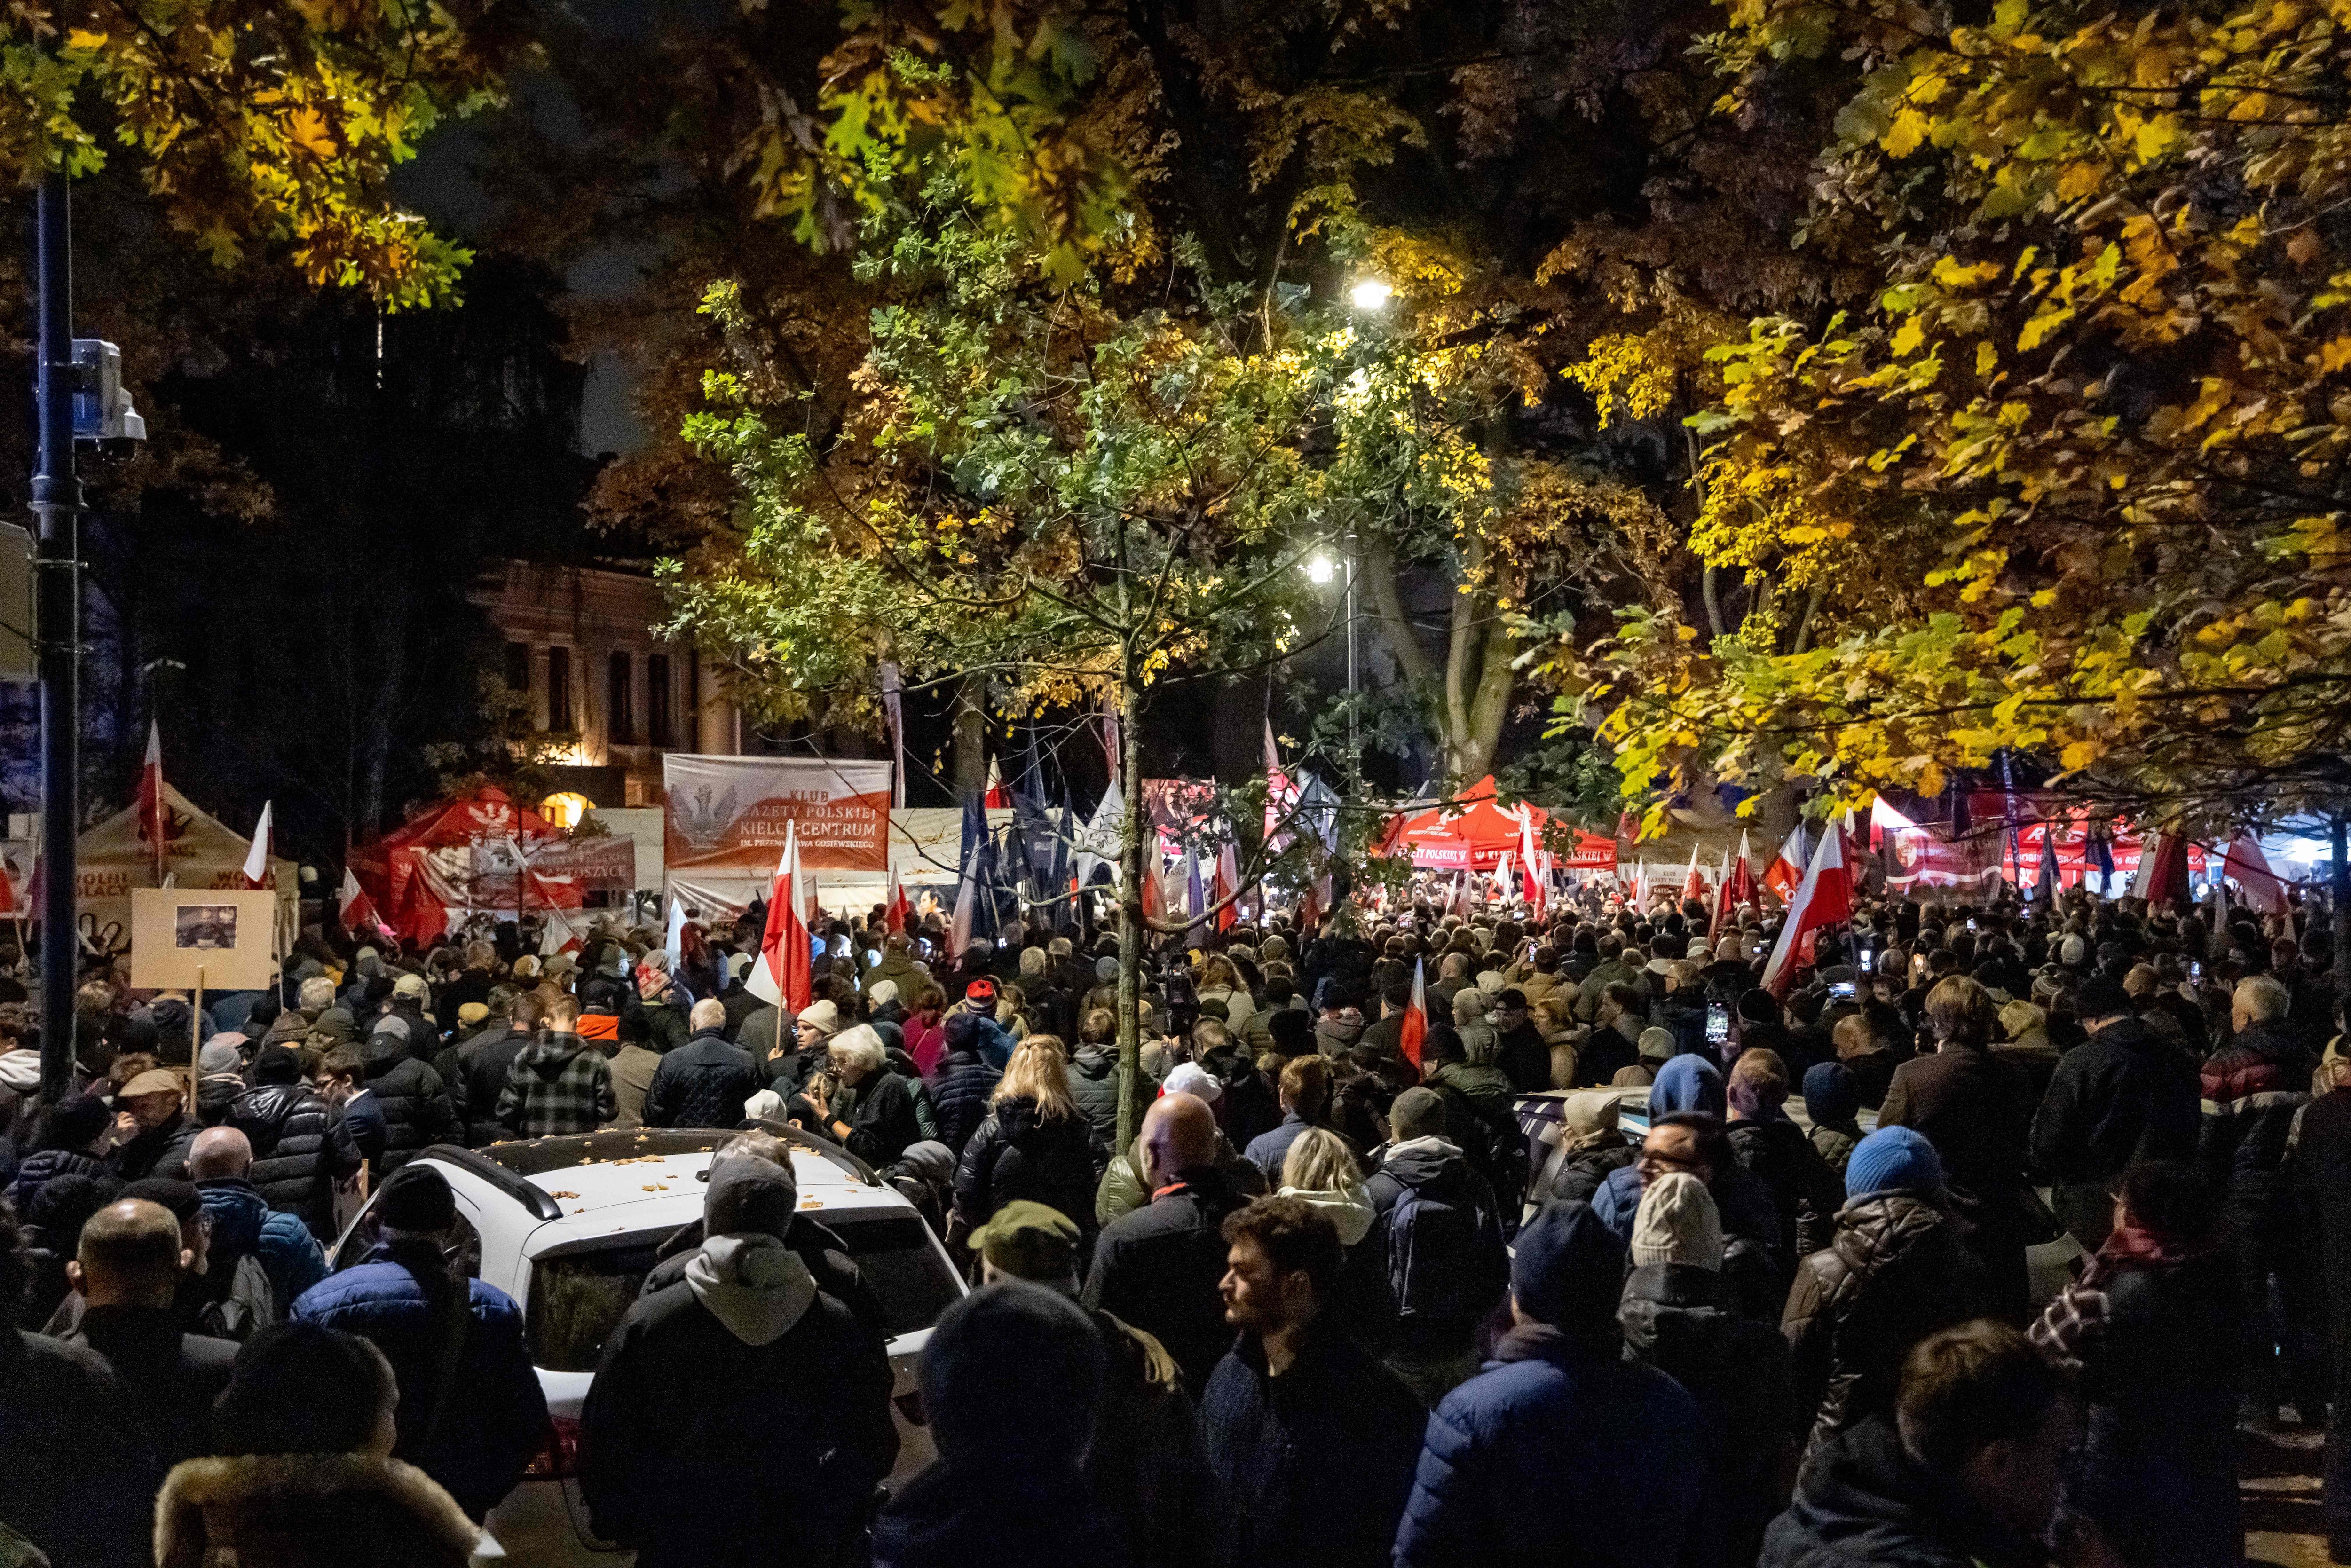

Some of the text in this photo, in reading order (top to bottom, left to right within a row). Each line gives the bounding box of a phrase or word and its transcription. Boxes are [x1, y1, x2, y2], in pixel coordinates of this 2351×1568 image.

[790, 790, 829, 803] KLUB
[806, 806, 876, 820] POLSKIEJ
[741, 822, 876, 836] KIELC-CENTRUM
[1426, 849, 1457, 862] POLSKIEJ
[547, 865, 627, 878] ARTOSZYCE
